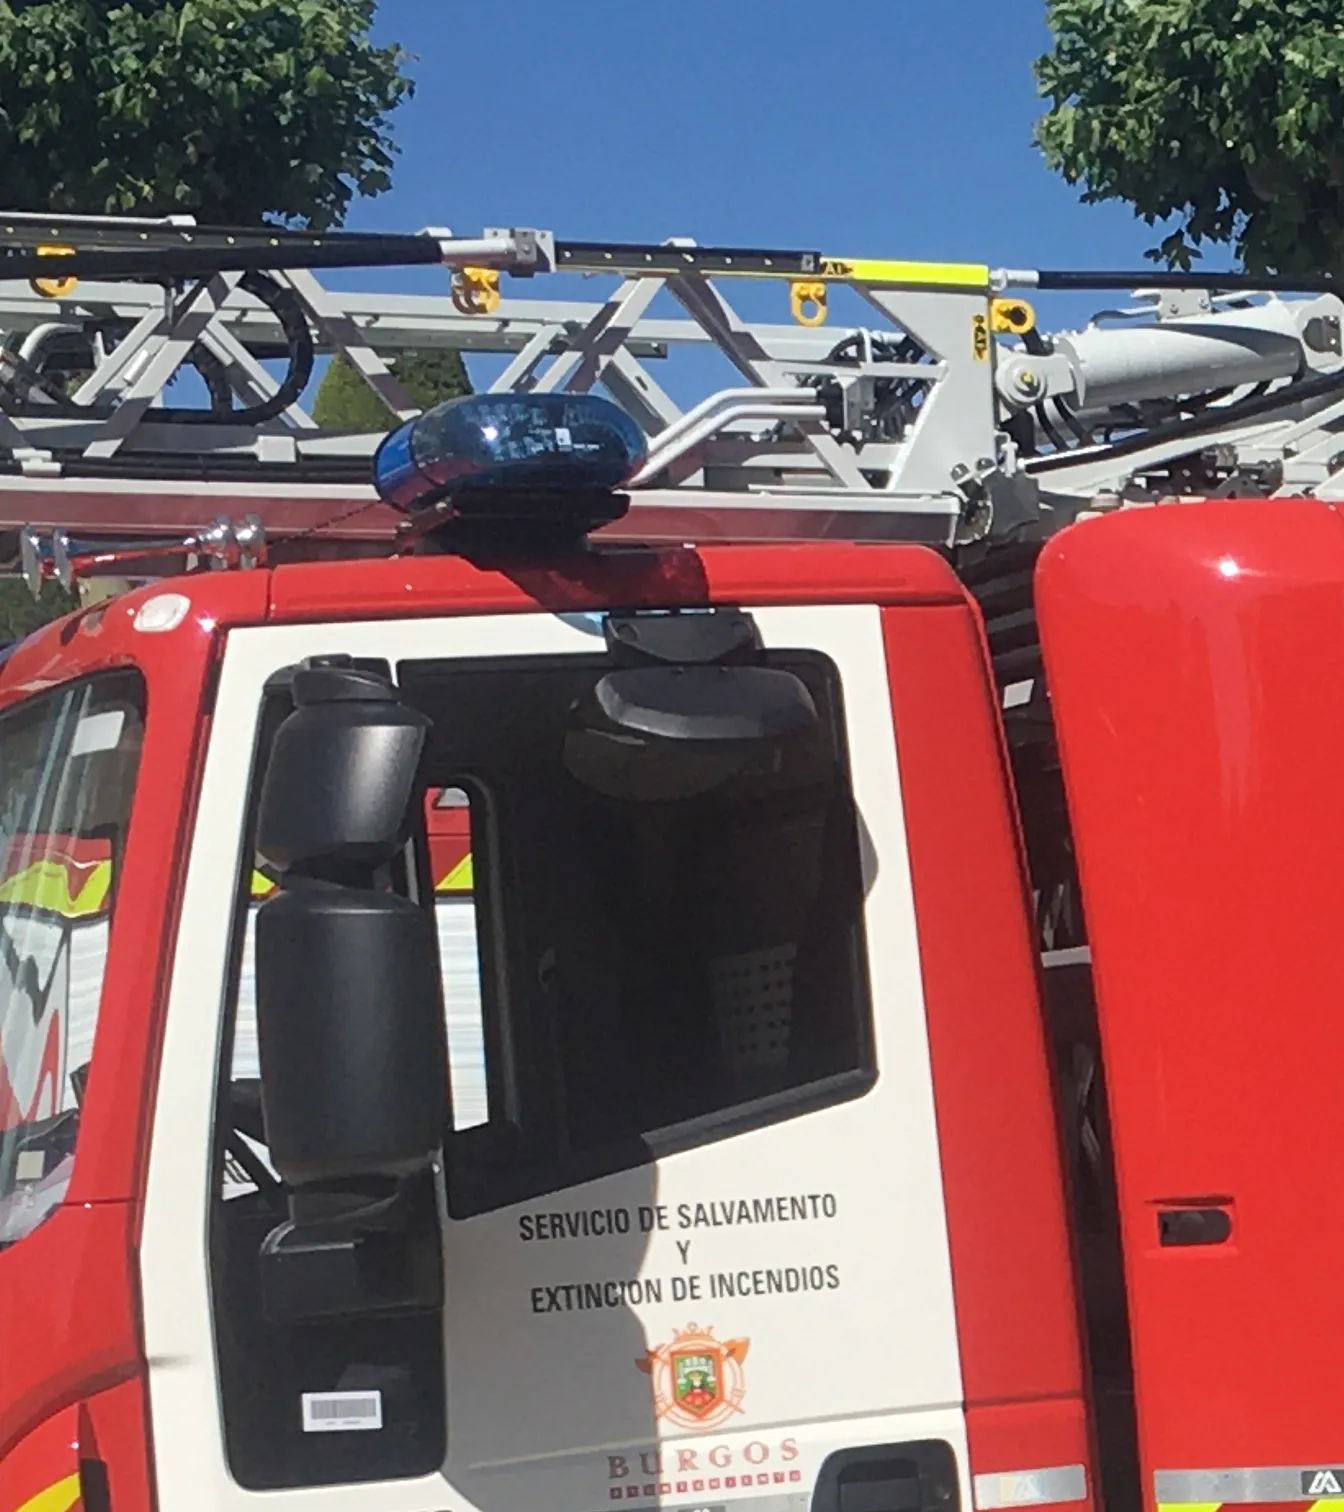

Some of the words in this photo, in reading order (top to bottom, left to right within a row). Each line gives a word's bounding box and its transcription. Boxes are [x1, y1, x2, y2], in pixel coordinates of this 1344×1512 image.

[519, 1207, 630, 1241] SERVICIO
[638, 1205, 670, 1233] DE
[677, 1193, 837, 1230] SALVAMENTO
[675, 1239, 691, 1265] Y
[530, 1278, 662, 1314] EXTINCION
[671, 1275, 701, 1302] DE
[709, 1264, 840, 1299] INCENDIOS
[607, 1437, 799, 1479] BURGOS
